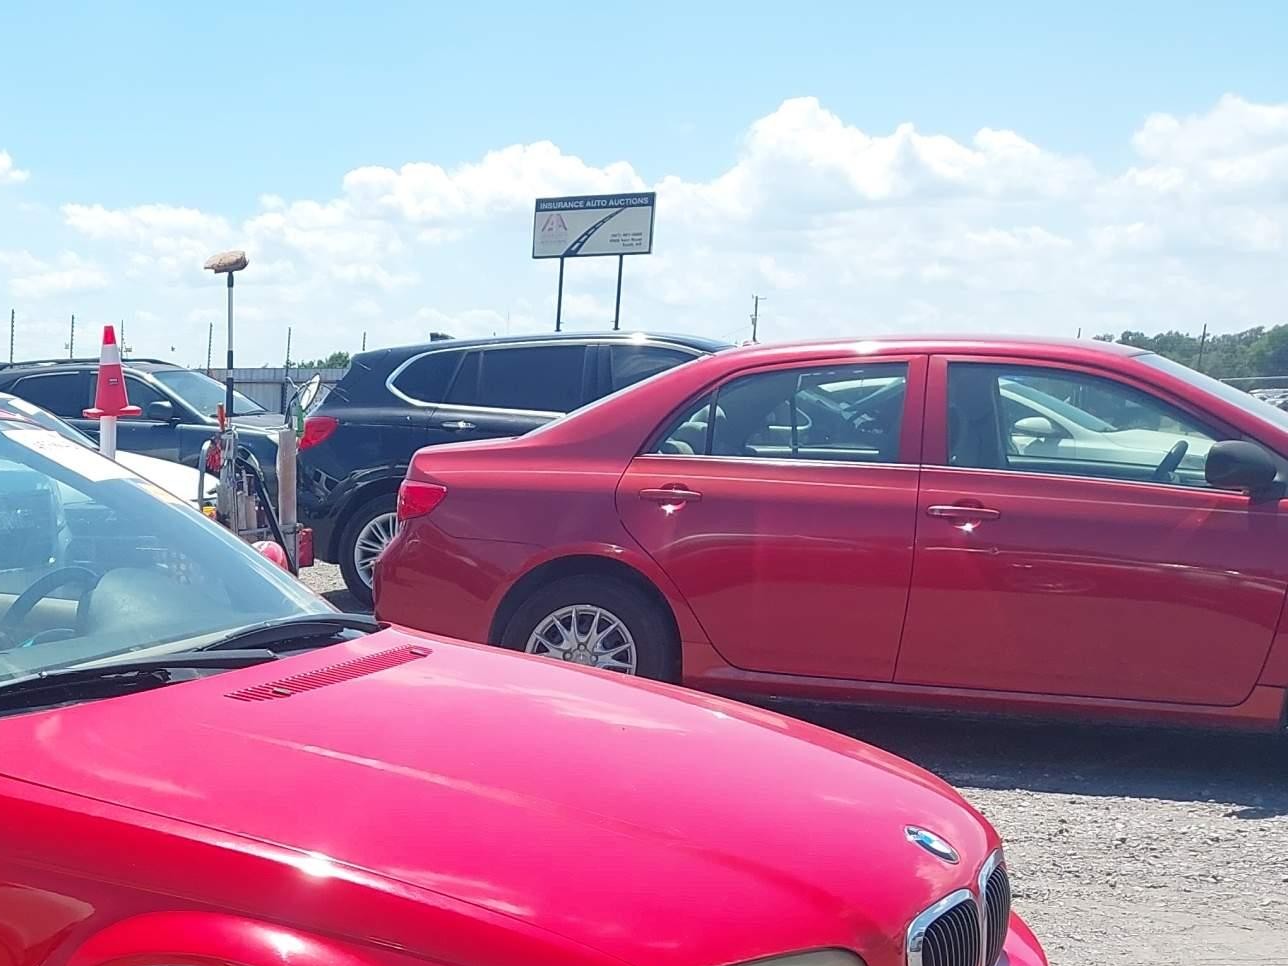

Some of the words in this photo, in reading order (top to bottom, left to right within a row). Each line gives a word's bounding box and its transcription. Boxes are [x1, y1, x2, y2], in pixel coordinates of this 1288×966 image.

[540, 200, 584, 209] INSURANCE
[585, 199, 607, 207] AUTO
[608, 197, 649, 206] AUCTIONS
